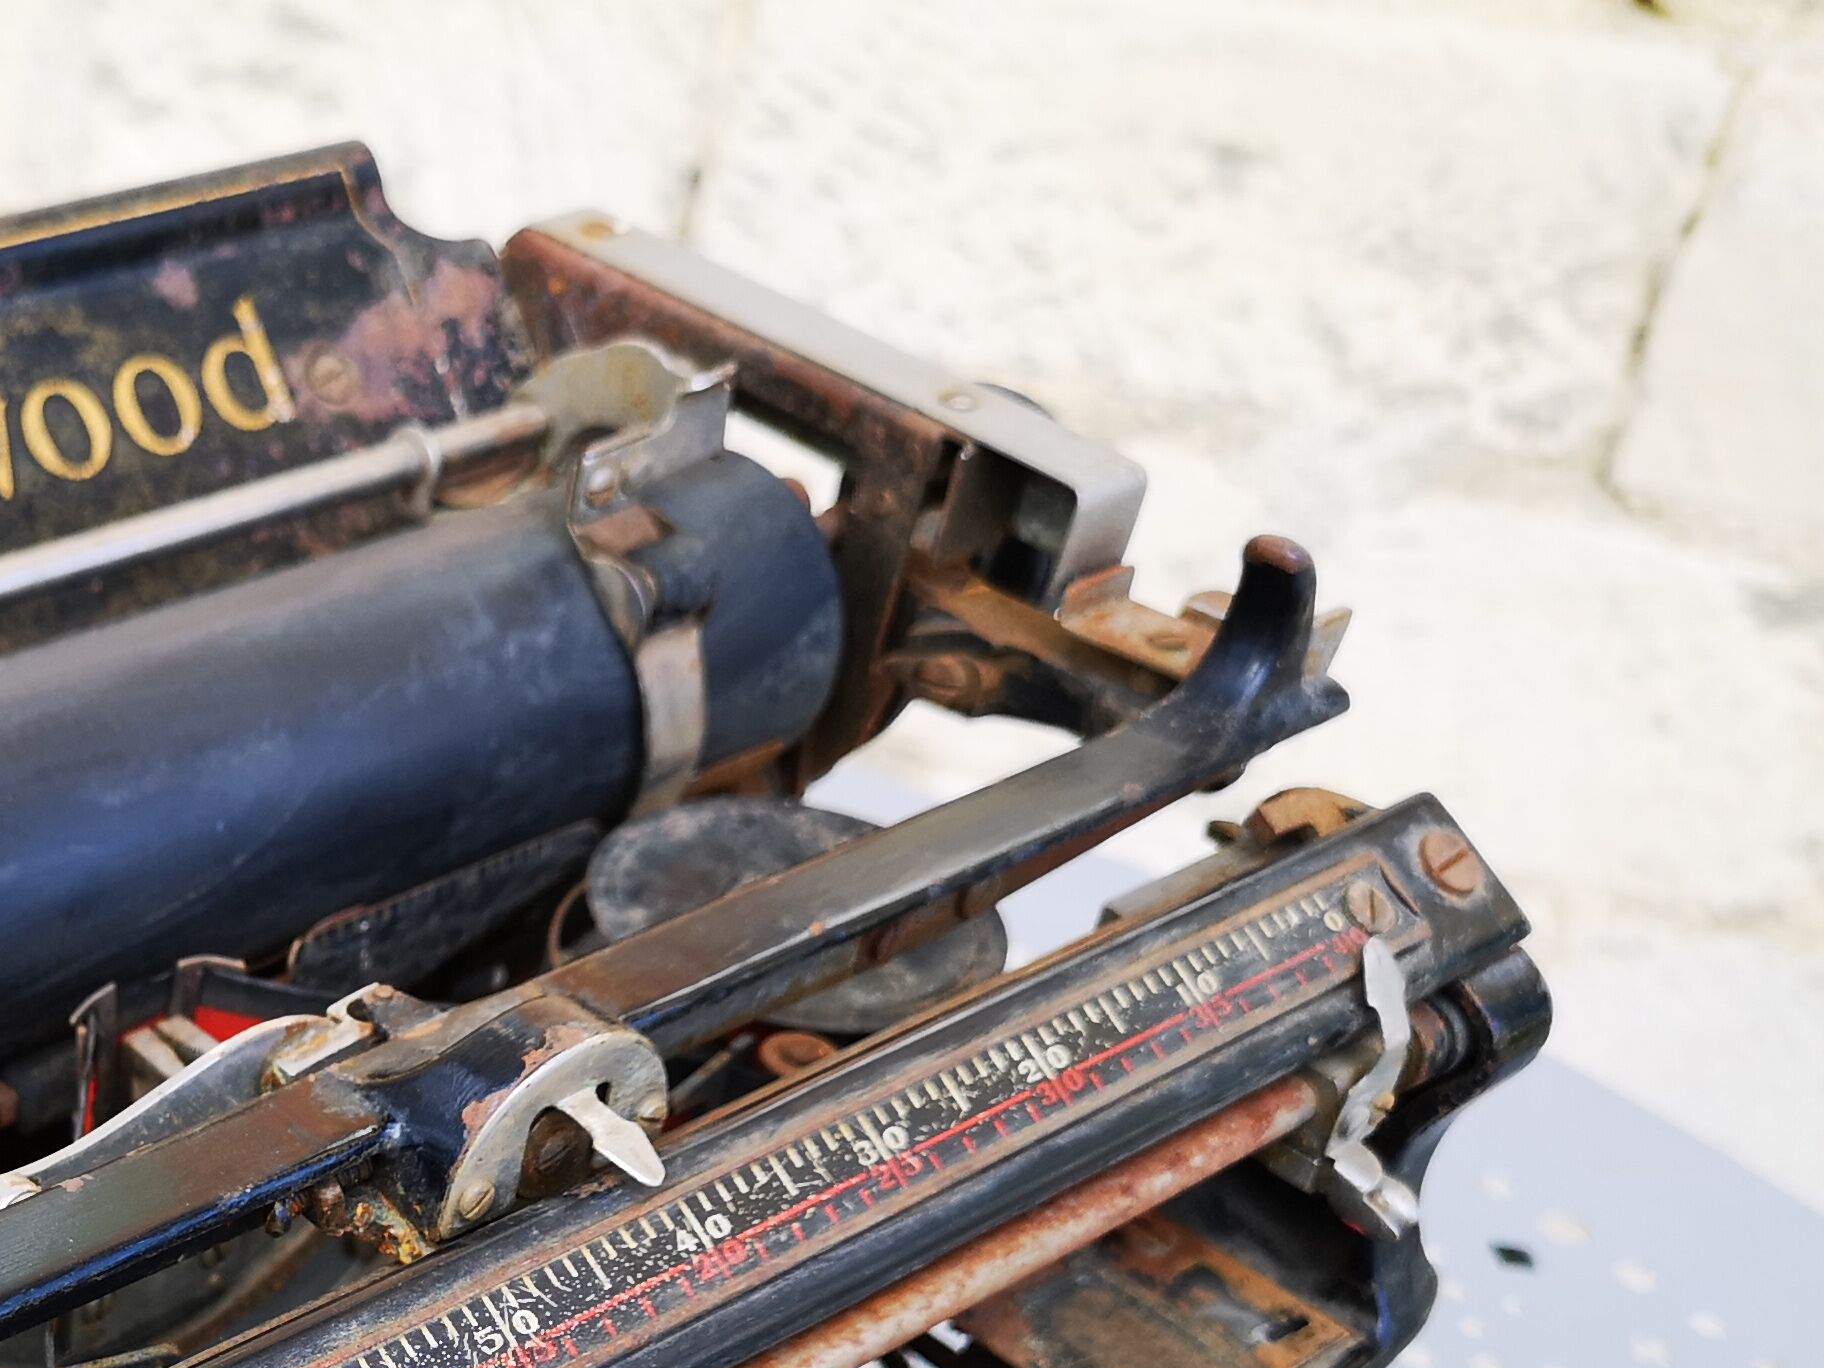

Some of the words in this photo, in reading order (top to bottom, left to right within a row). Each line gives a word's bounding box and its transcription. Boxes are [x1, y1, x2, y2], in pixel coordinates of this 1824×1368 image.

[473, 1310, 539, 1354] 50
[676, 1213, 733, 1251] 40
[852, 1126, 909, 1167] 30
[1017, 1044, 1073, 1083] 20
[1176, 966, 1219, 1006] 10
[693, 1239, 749, 1280] 20
[870, 1152, 926, 1190] 25
[1036, 1067, 1087, 1105] 30
[1189, 994, 1233, 1028] 35
